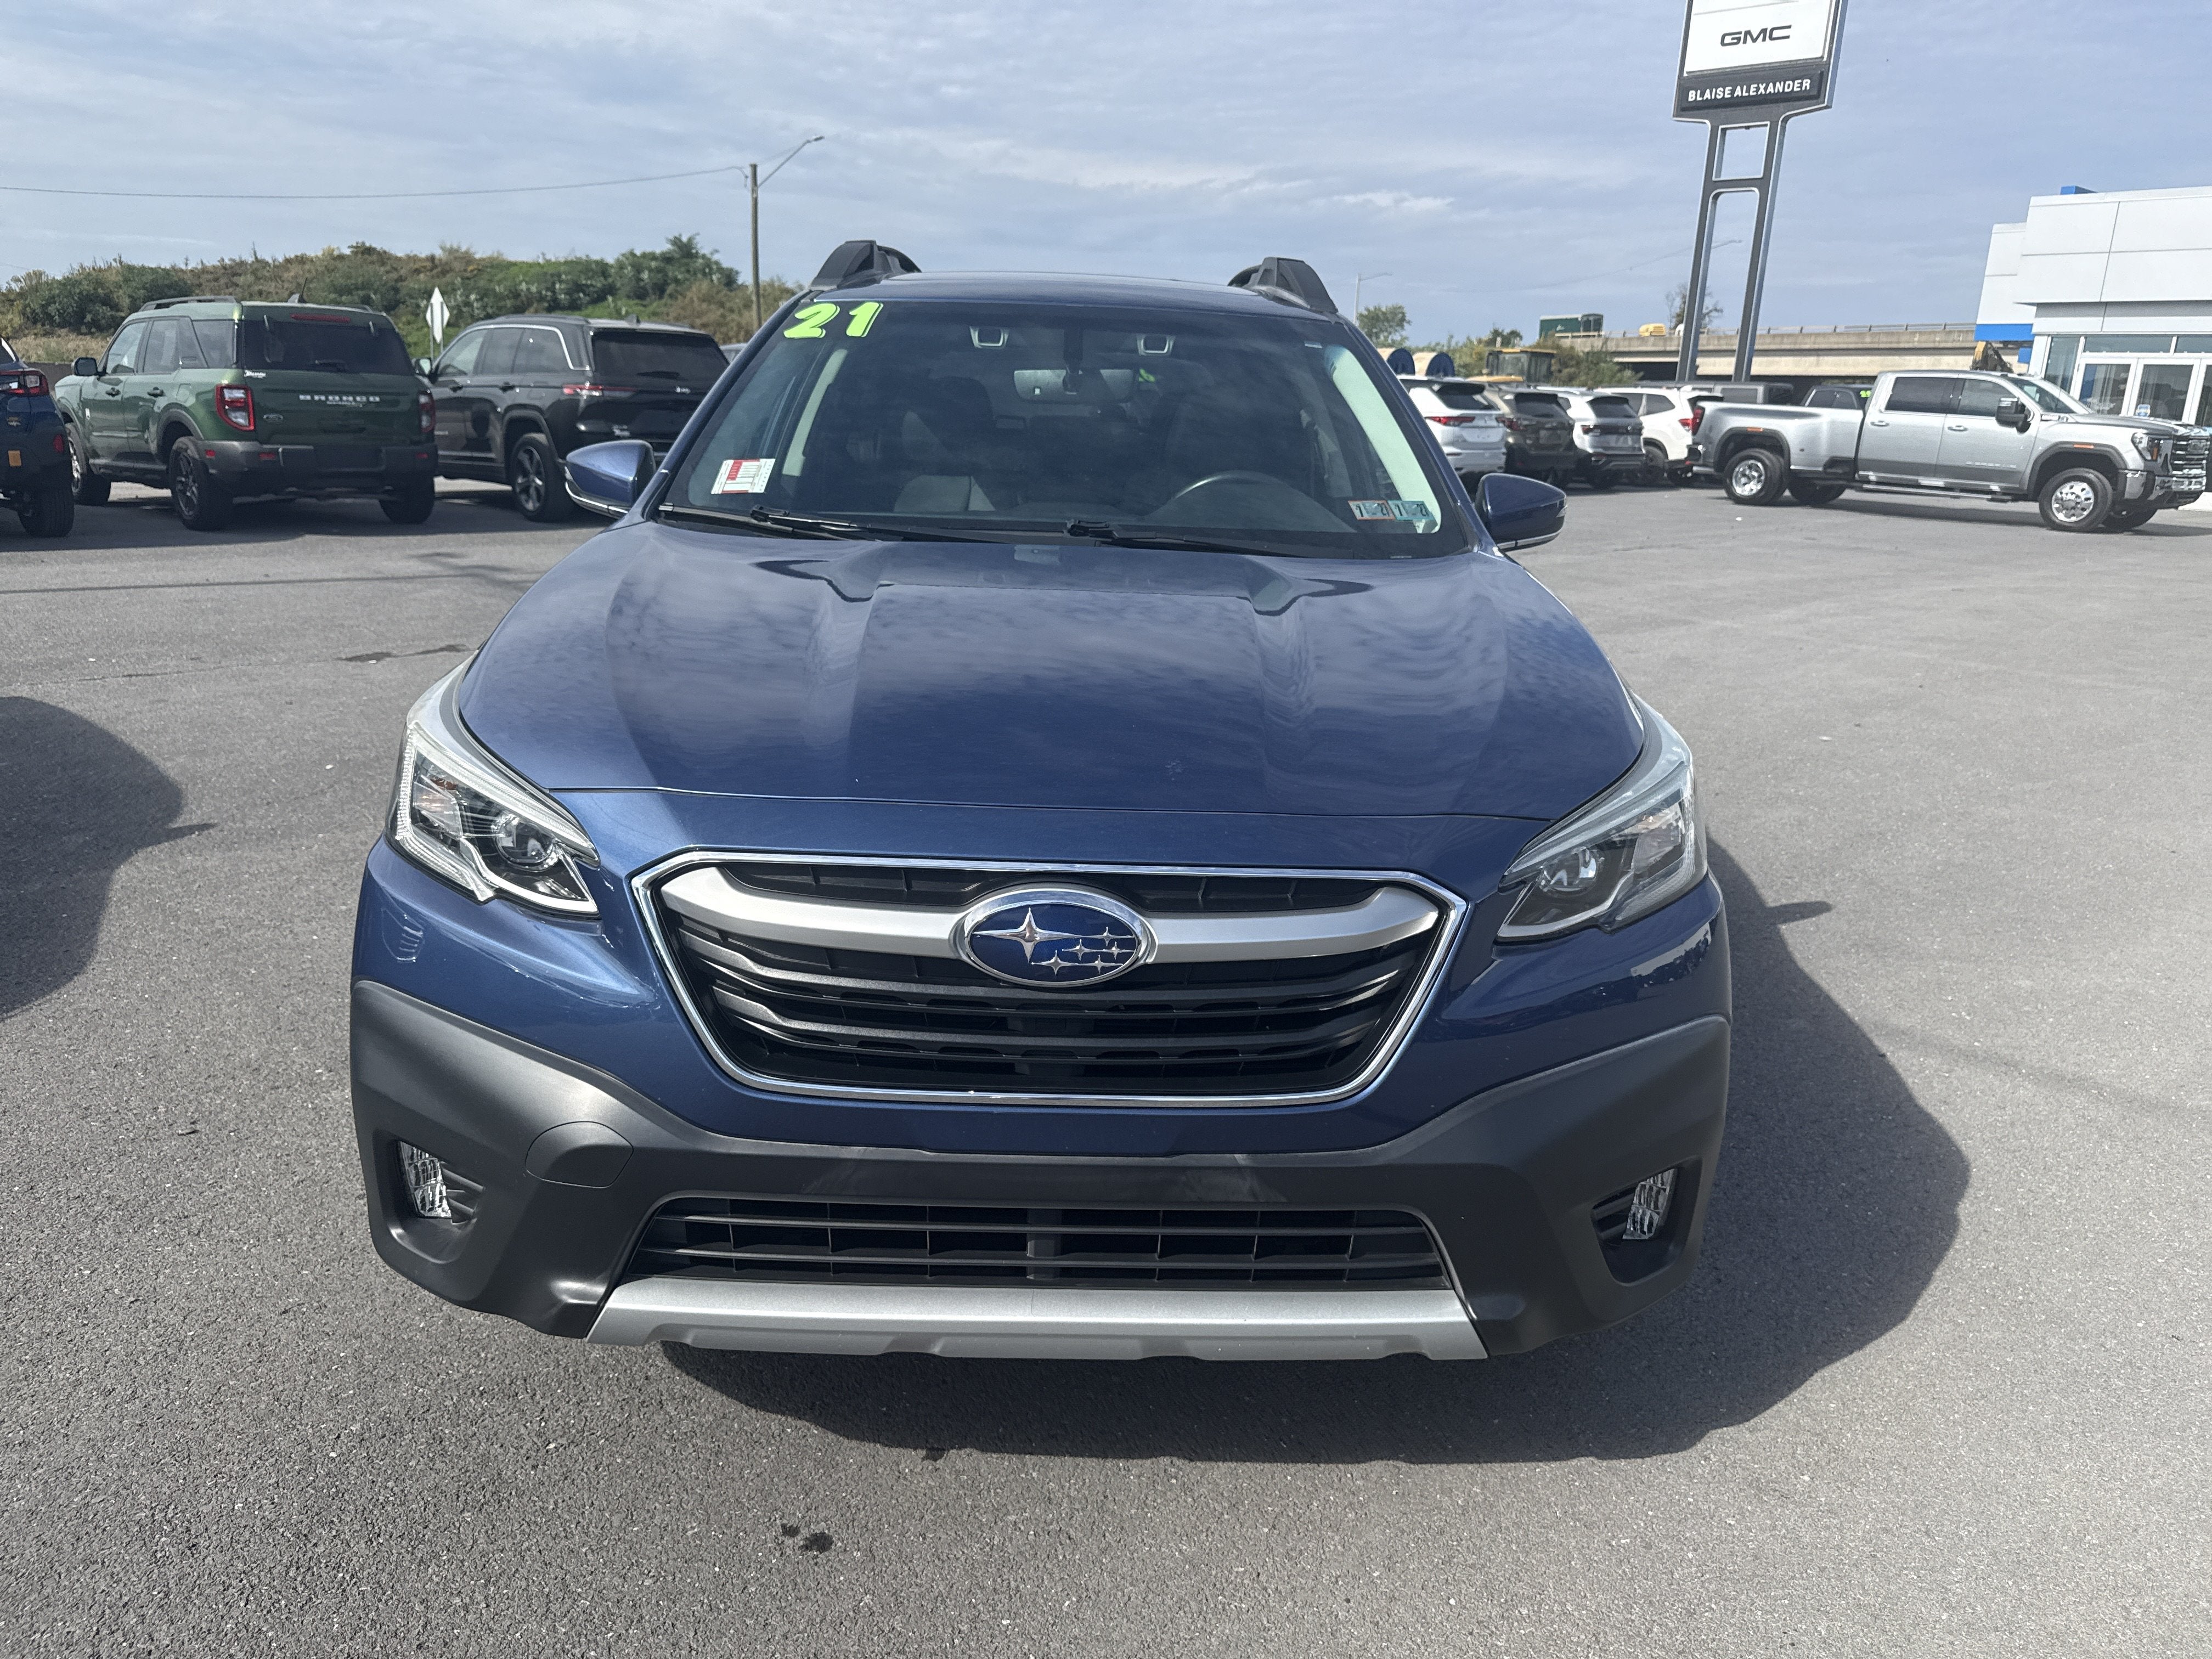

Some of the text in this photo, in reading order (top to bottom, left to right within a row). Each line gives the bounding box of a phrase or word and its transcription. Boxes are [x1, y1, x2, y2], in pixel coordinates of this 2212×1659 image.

[1720, 25, 1792, 47] GMC
[1688, 78, 1811, 101] BLAISE ALEXANDER
[783, 302, 884, 338] 21
